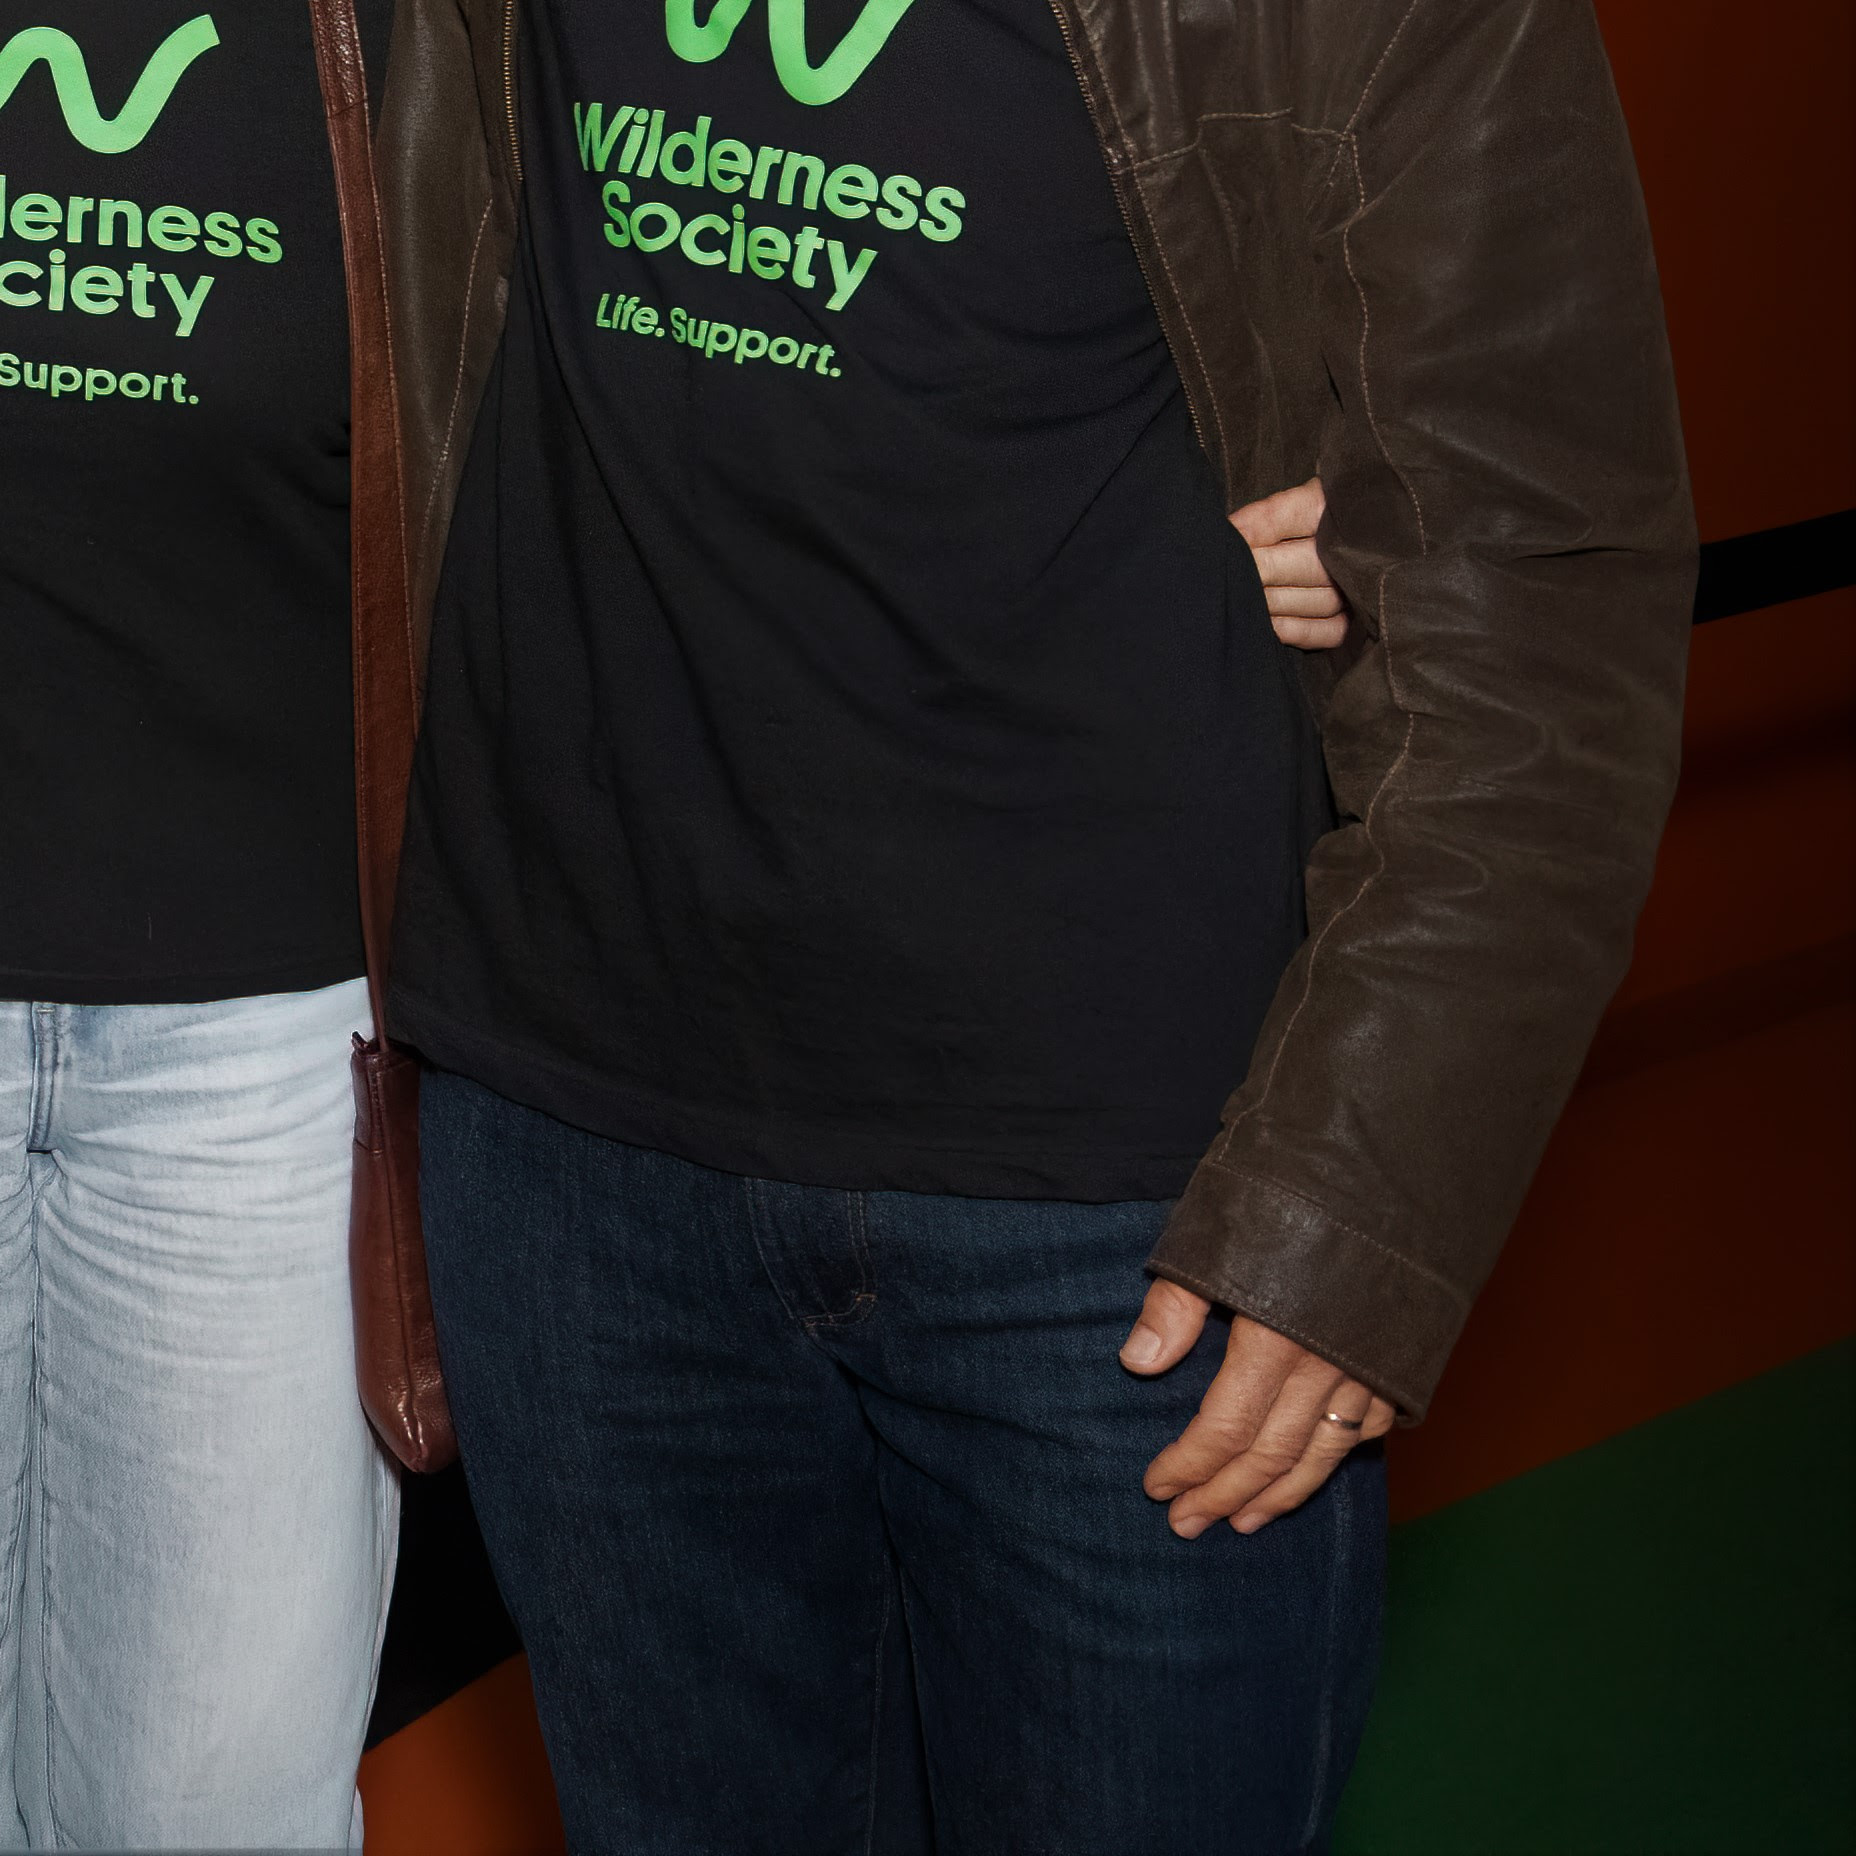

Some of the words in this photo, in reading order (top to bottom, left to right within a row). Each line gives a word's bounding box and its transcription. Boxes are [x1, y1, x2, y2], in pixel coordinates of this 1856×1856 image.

[574, 102, 967, 243] Wilderness
[602, 180, 879, 311] Society
[596, 293, 666, 338] Life.
[671, 307, 843, 378] Support.
